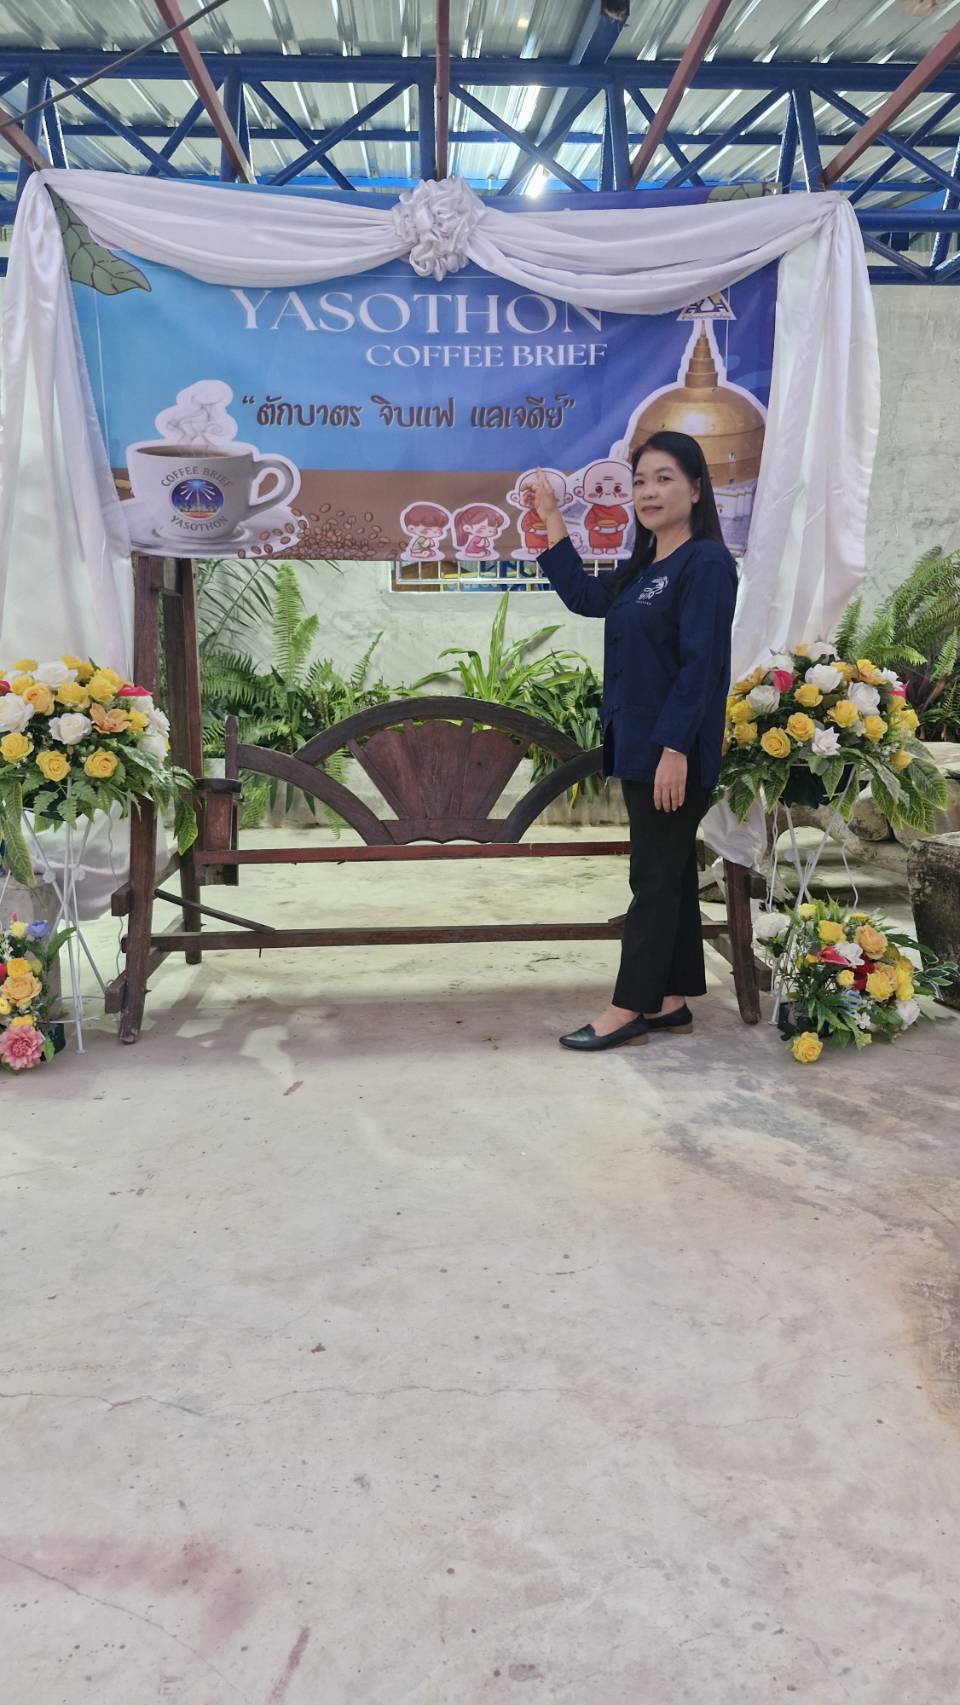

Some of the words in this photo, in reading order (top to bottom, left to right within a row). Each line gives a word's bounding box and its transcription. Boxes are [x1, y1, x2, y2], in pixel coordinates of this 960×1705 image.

[230, 289, 603, 334] YASOTHON
[365, 344, 504, 368] COFFEE
[511, 343, 608, 368] BRIEF
[370, 393, 455, 428] จิบแฟ
[160, 466, 199, 487] COFFEE
[203, 468, 232, 487] BRIEF
[170, 515, 228, 532] YASOTHON
